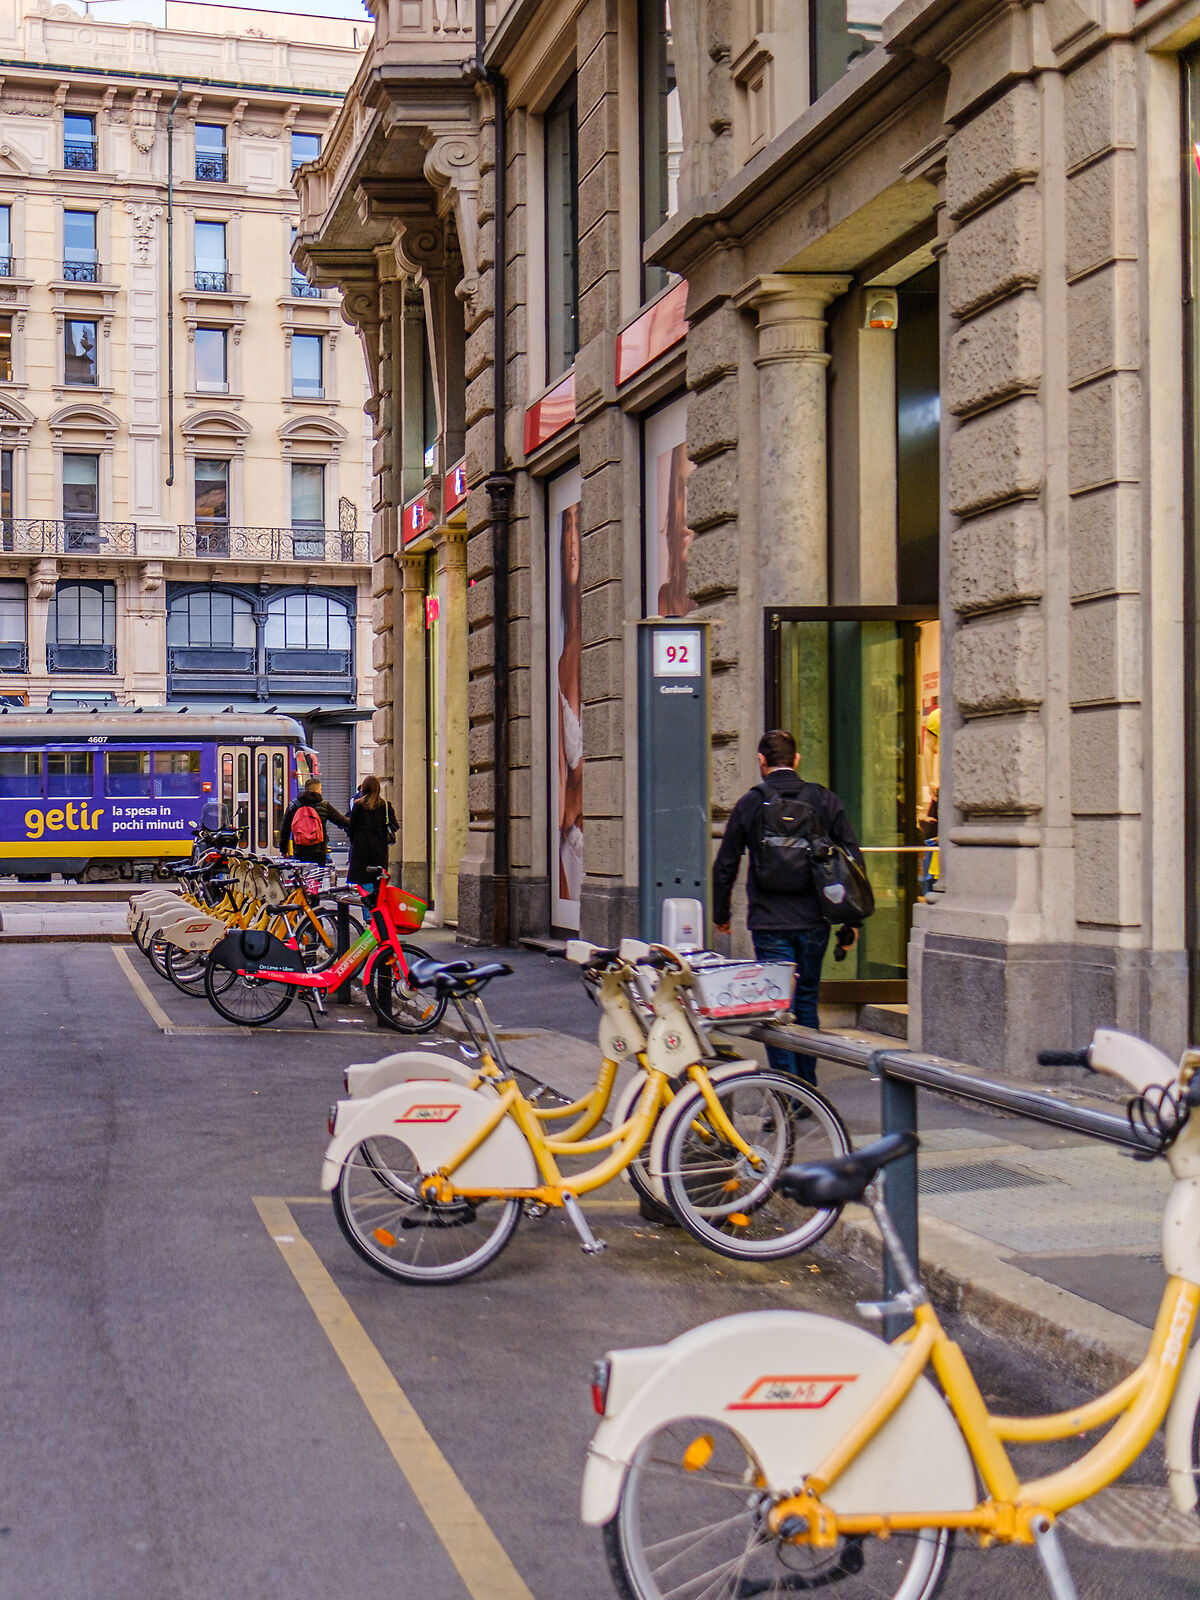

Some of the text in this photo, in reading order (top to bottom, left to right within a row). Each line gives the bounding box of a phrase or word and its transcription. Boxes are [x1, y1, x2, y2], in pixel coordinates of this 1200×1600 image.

[666, 645, 688, 664] 92
[112, 805, 171, 818] la spesa in
[24, 802, 104, 839] getir
[112, 819, 184, 832] pochi minuti
